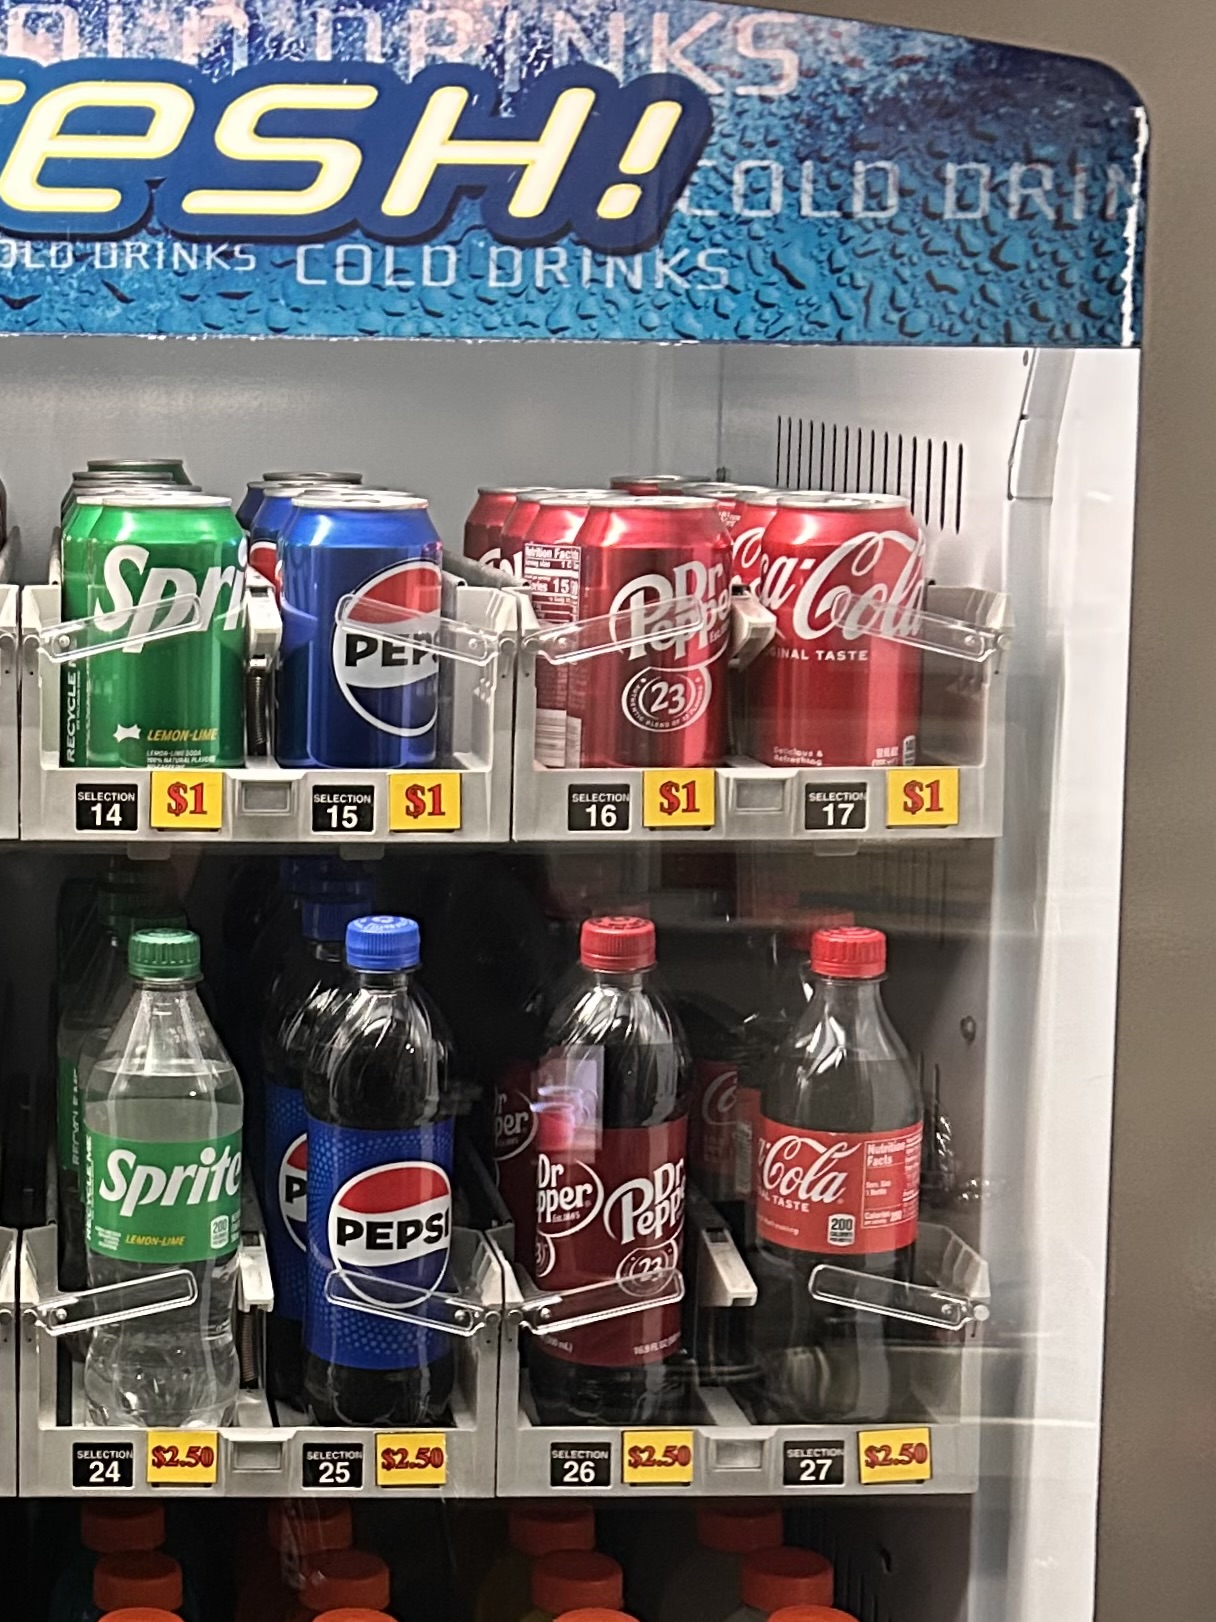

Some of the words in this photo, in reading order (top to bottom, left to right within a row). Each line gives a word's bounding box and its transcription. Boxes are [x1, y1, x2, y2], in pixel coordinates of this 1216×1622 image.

[677, 158, 900, 218] COLD
[92, 240, 257, 272] DRINKS
[295, 242, 458, 287] COLD
[486, 244, 730, 291] DRINKS
[673, 560, 725, 605] Dr
[815, 649, 869, 662] TASTE
[650, 681, 686, 715] 23
[66, 674, 76, 762] RECYCLE
[147, 727, 219, 742] LEMON-LIME
[77, 791, 136, 801] SELECTION
[166, 782, 207, 818] $1
[313, 793, 372, 803] SELECTION
[404, 784, 446, 819] $1
[571, 792, 629, 802] SELECTION
[658, 781, 700, 816] $1
[808, 791, 865, 801] SELECTION
[902, 780, 944, 815] $1
[90, 802, 123, 827] 14
[326, 804, 358, 829] 15
[585, 803, 617, 828] 16
[822, 802, 855, 826] 17
[537, 1153, 565, 1190] Dr
[866, 1155, 893, 1167] Facts
[98, 1145, 242, 1218] Sprite
[772, 1194, 810, 1213] TASTE
[212, 1218, 228, 1234] 200
[336, 1211, 450, 1251] PEPSI
[830, 1217, 854, 1231] 200
[124, 1233, 187, 1247] LEMON-LIME
[76, 1449, 133, 1459] SELECTION
[151, 1444, 215, 1470] $2.50
[306, 1450, 362, 1460] SELECTION
[381, 1445, 444, 1471] $2.50
[551, 1449, 609, 1459] SELECTION
[627, 1443, 692, 1469] $2.50
[786, 1447, 843, 1457] SELECTION
[864, 1441, 929, 1467] $2.50
[89, 1460, 121, 1483] 24
[318, 1461, 351, 1484] 25
[563, 1460, 596, 1483] 26
[799, 1458, 833, 1481] 27
